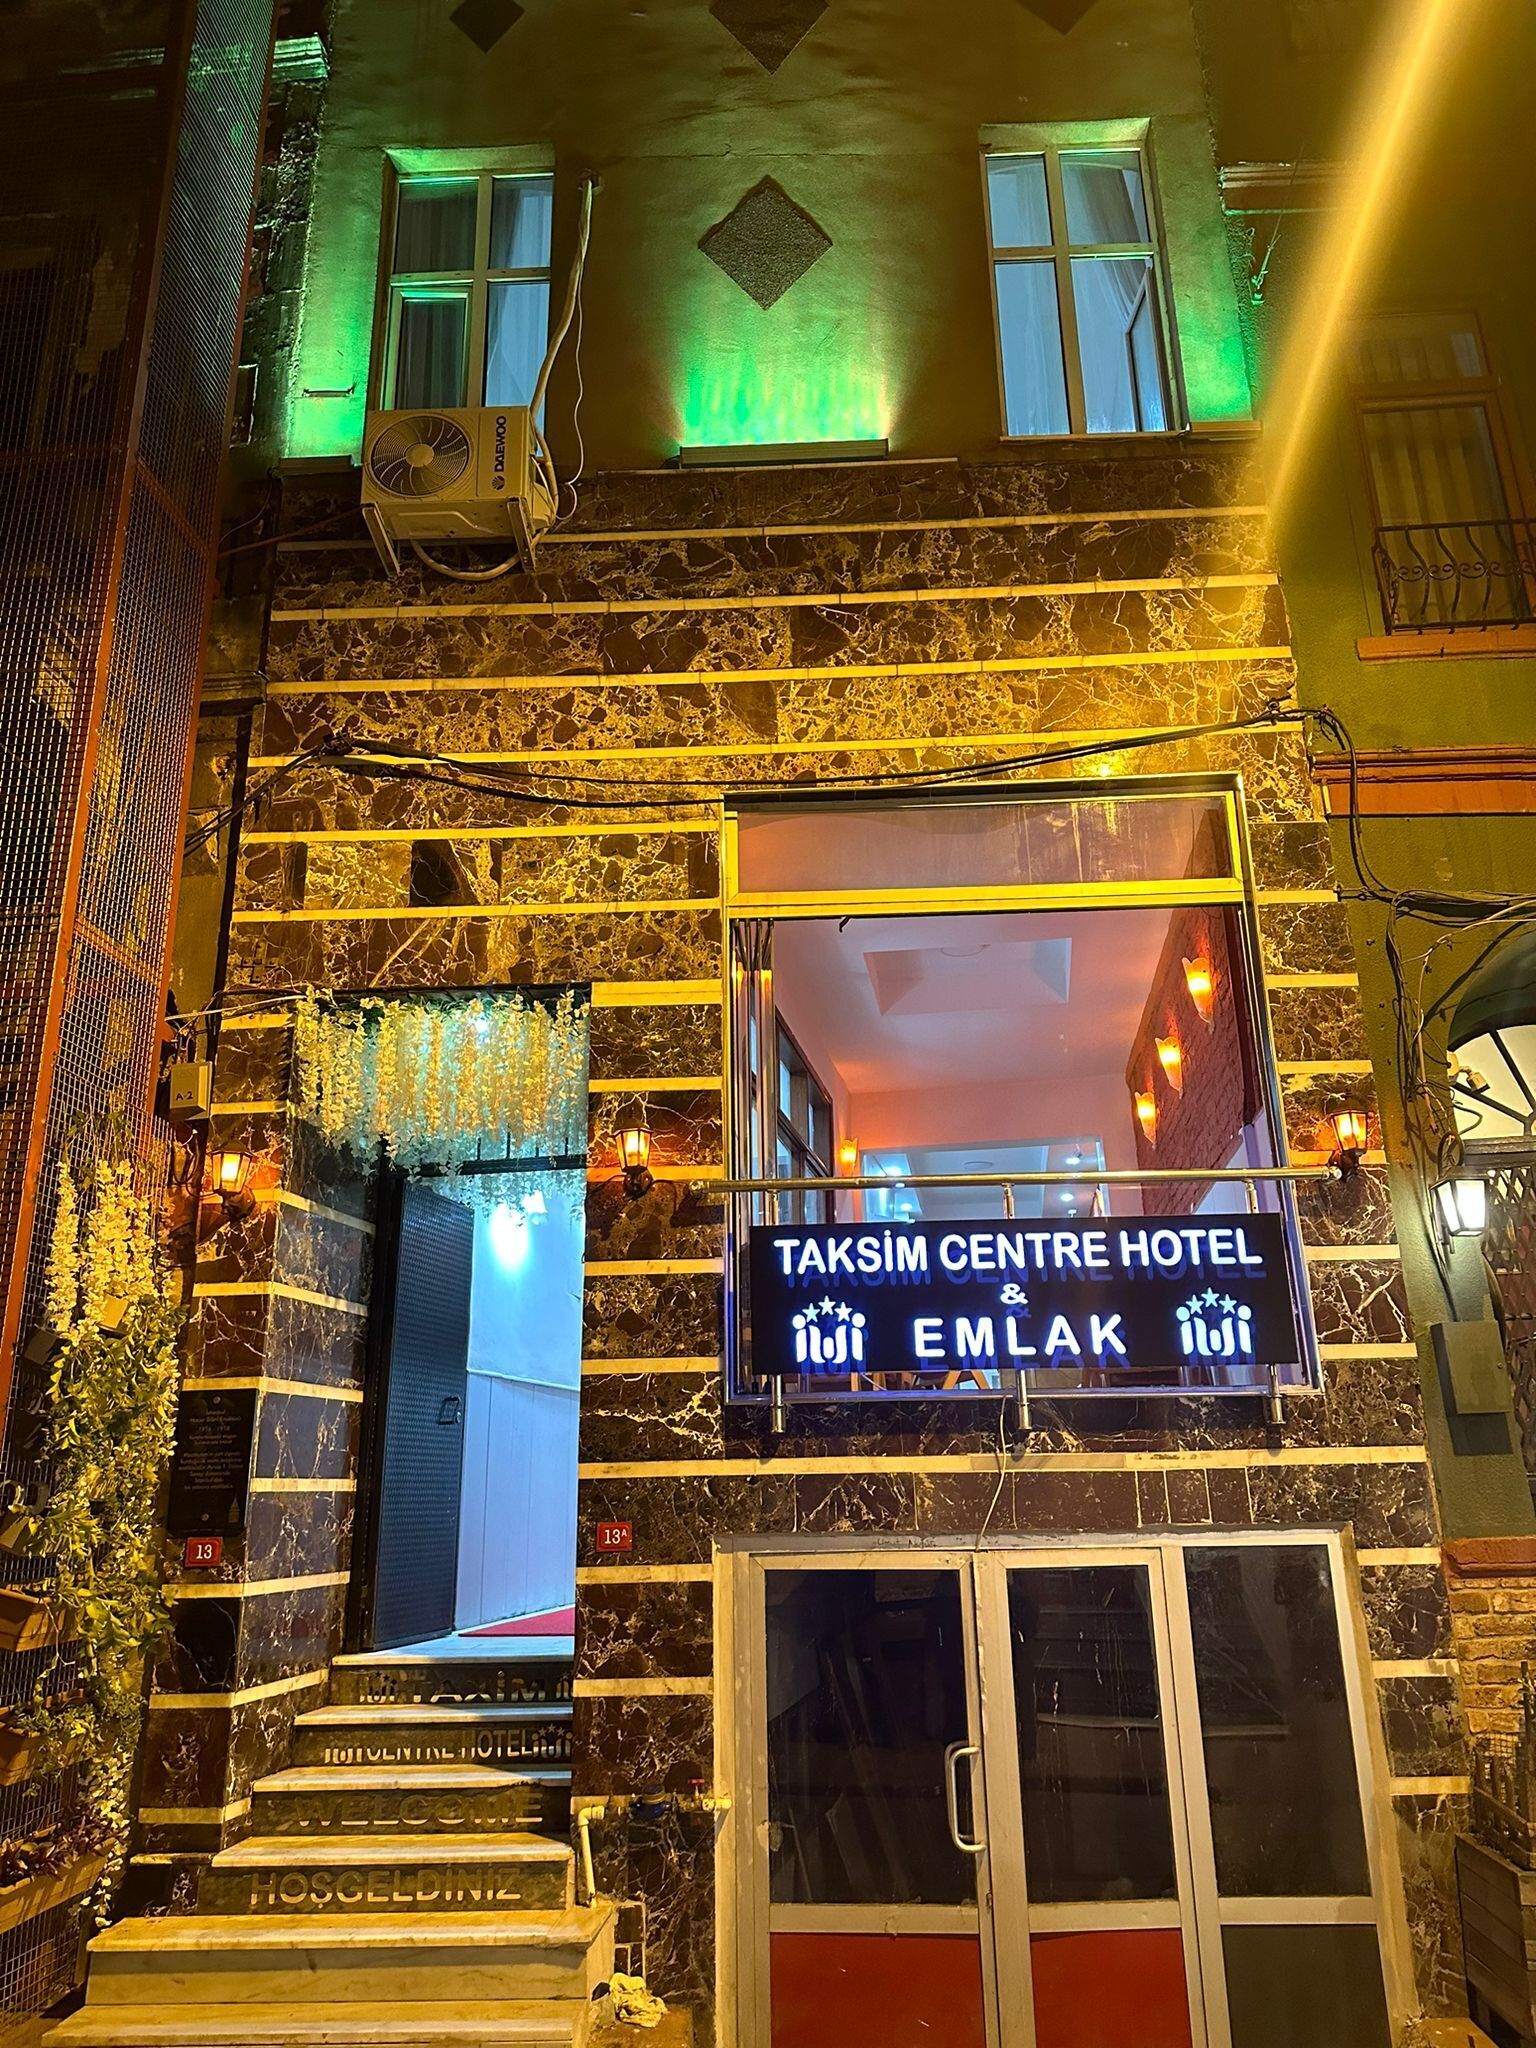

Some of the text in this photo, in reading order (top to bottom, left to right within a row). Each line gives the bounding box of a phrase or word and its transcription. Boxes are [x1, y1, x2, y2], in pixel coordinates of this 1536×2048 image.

[494, 415, 507, 473] DAEWOO
[773, 1226, 1263, 1275] TAKSİM CENTRE HOTEL
[999, 1282, 1029, 1306] &
[913, 1313, 1128, 1358] EMLAK
[196, 1543, 213, 1560] 13
[460, 1729, 533, 1759] HOTEL
[299, 1792, 544, 1827] WELCOME
[250, 1862, 522, 1909] HOŞGELDİNİZ
